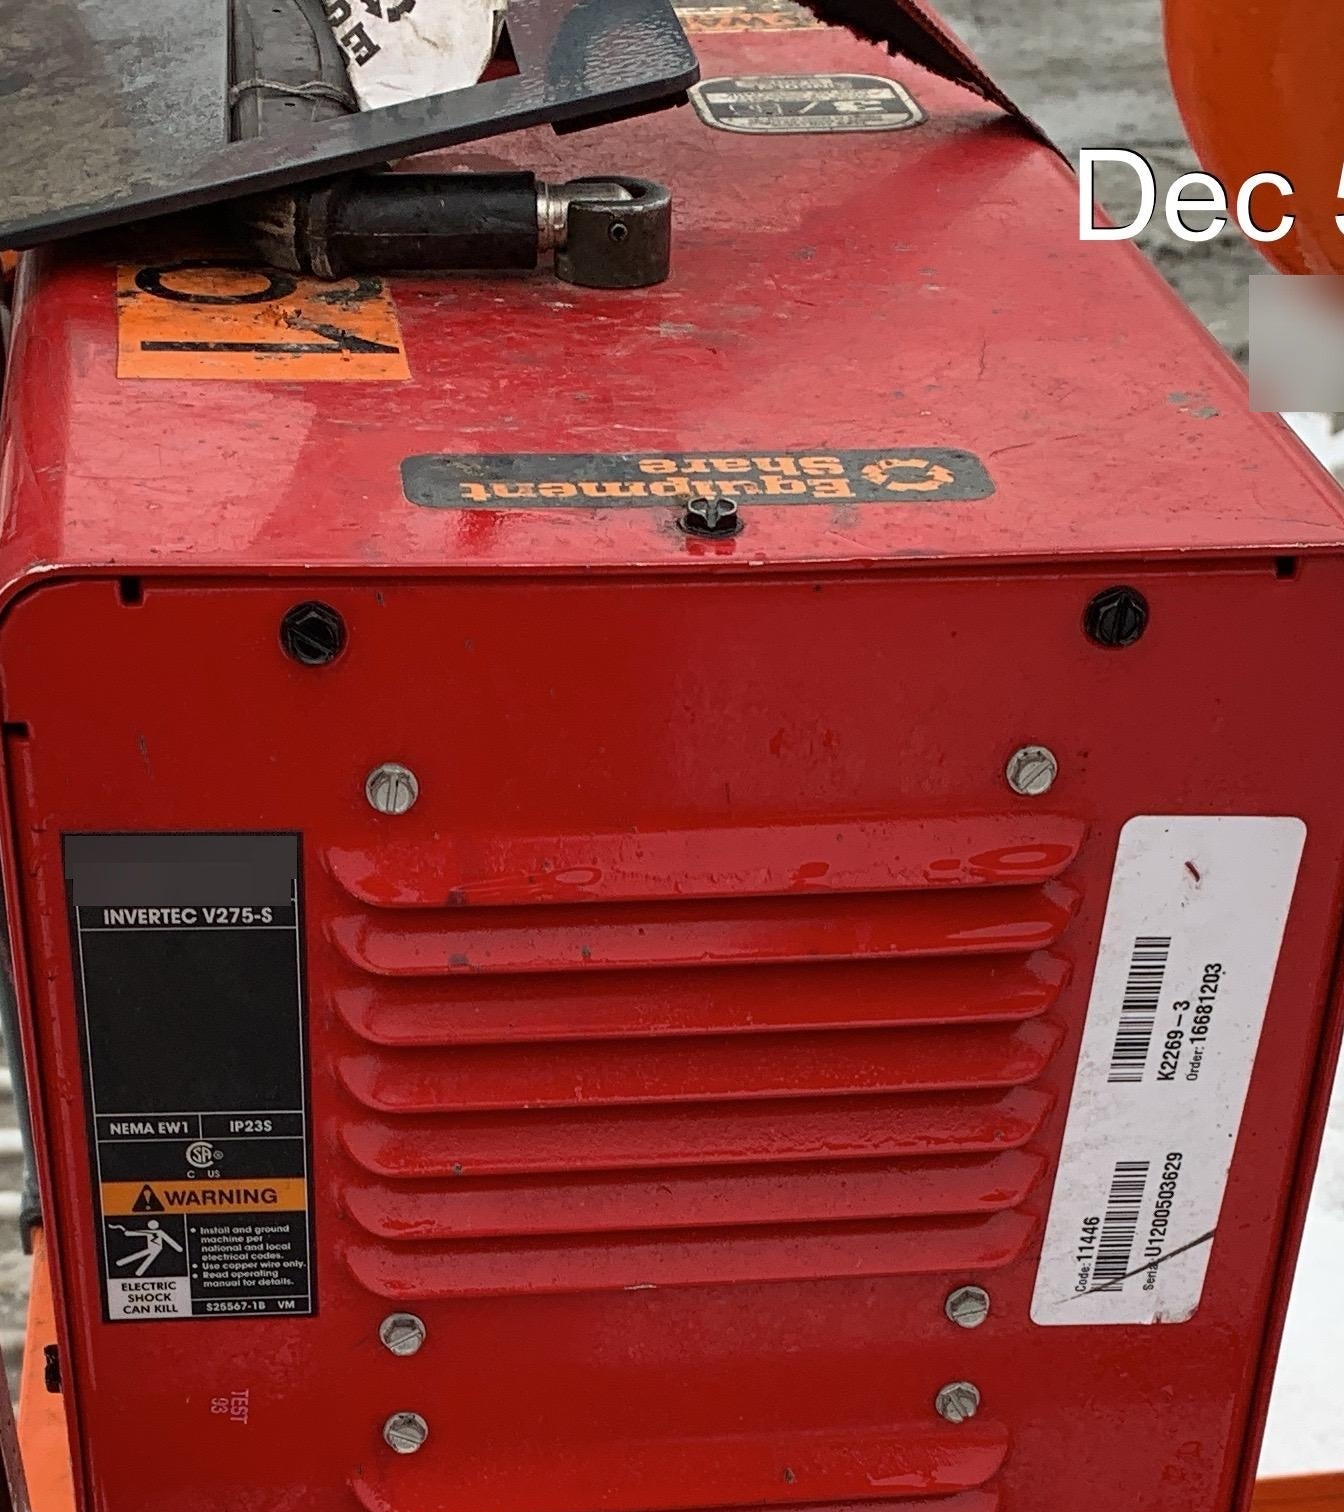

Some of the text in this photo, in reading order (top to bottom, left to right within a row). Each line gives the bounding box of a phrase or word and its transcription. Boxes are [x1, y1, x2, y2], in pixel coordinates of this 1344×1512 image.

[638, 455, 845, 476] Share
[459, 475, 857, 502] Equipment
[103, 906, 273, 925] INVERTEC V275-S
[109, 1121, 189, 1135] NEMA EW1
[229, 1119, 273, 1133] IP23S
[186, 1169, 221, 1179] C US
[163, 1187, 278, 1206] WARNING
[200, 1224, 290, 1235] Install and ground
[200, 1235, 263, 1243] machine per
[201, 1242, 291, 1252] national and local
[201, 1252, 285, 1261] electrical codes.
[202, 1262, 220, 1270] Use
[222, 1262, 257, 1270] copper
[282, 1260, 307, 1269] only.
[230, 1270, 279, 1278] operating
[121, 1281, 177, 1292] ELECTRIC
[203, 1279, 241, 1288] manual
[257, 1278, 294, 1286] details.
[127, 1292, 172, 1303] SHOCK
[123, 1304, 178, 1315] CAN KILL
[277, 1300, 295, 1309] VM
[230, 1388, 249, 1424] TEST
